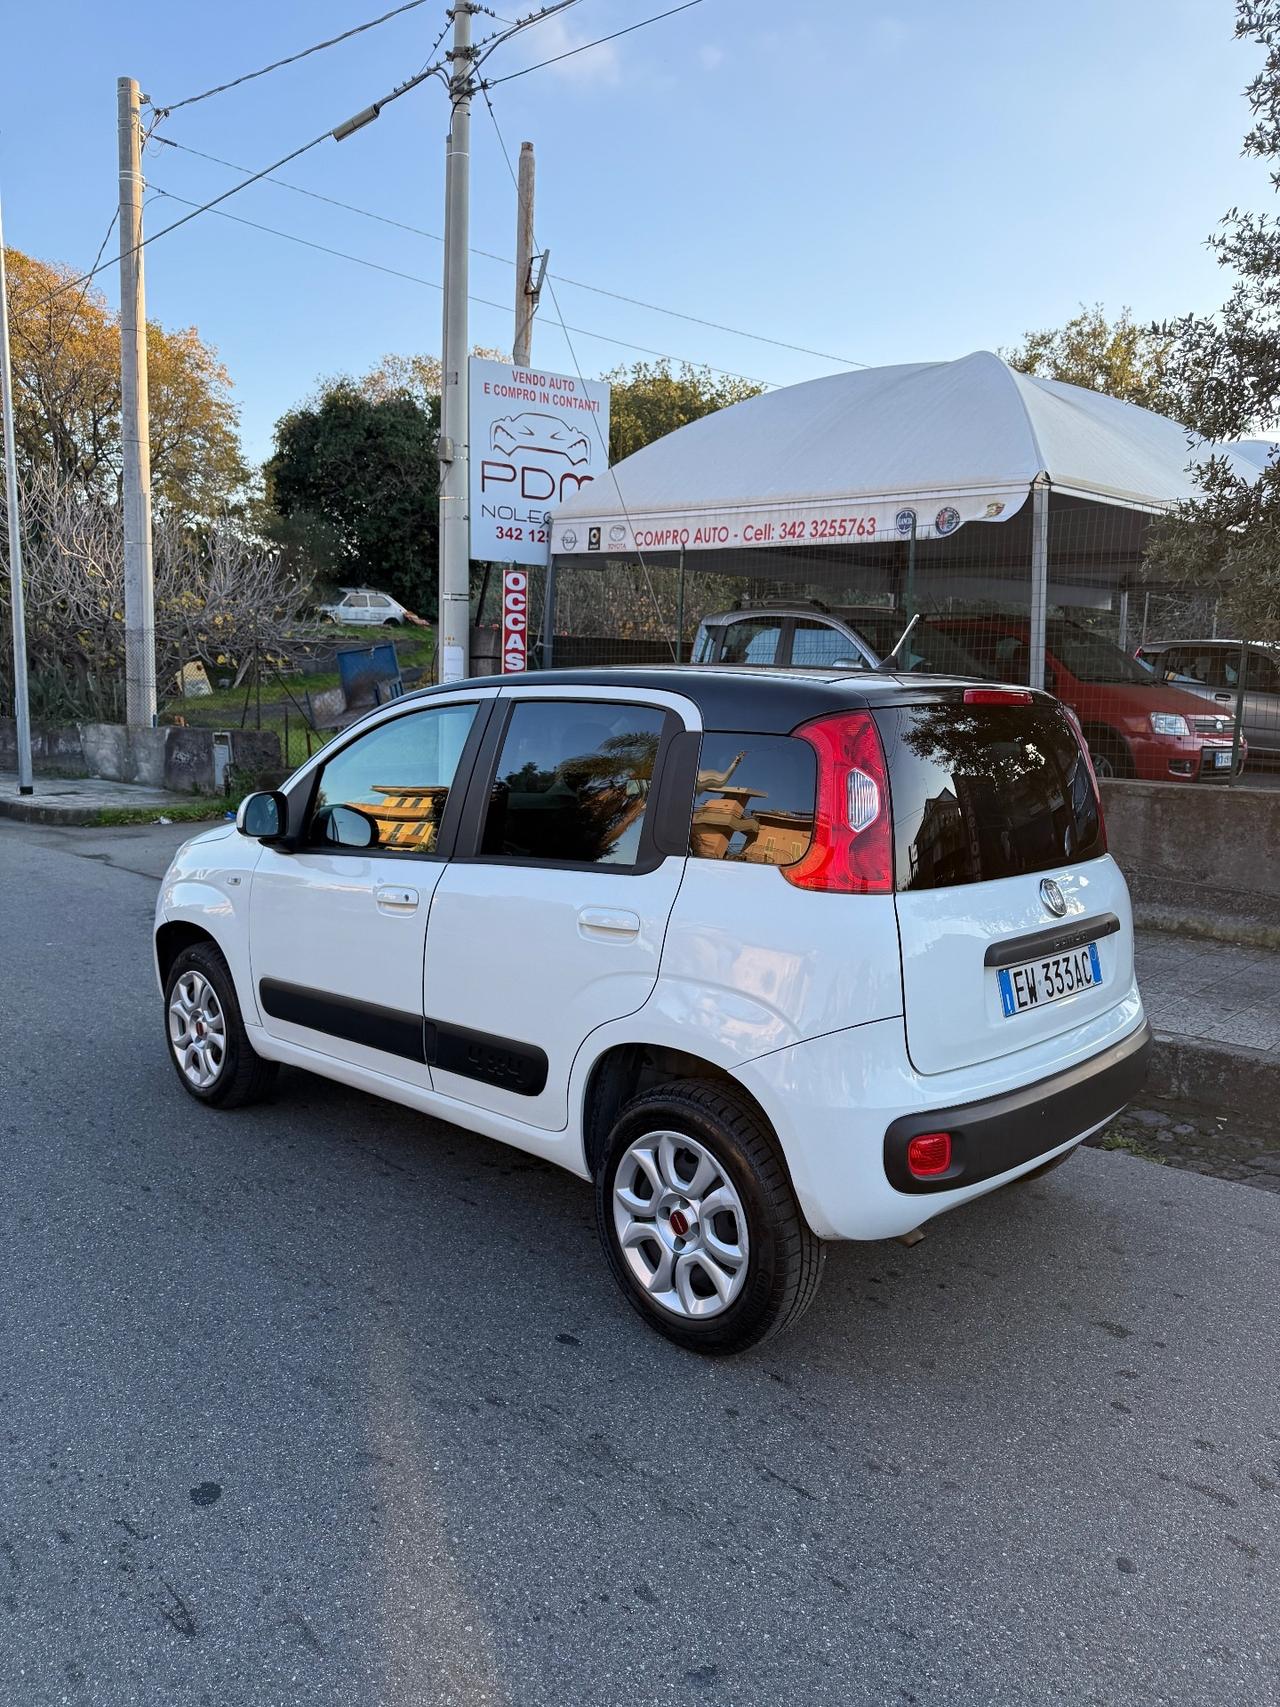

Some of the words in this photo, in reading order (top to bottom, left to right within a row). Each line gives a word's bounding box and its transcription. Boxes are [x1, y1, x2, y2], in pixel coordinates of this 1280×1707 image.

[512, 370, 546, 387] VENDO
[549, 378, 575, 392] AUTO
[483, 382, 491, 395] E
[493, 384, 536, 402] COMPRO
[539, 391, 550, 404] IN
[552, 394, 600, 413] CONTANTI
[495, 526, 523, 541] 342
[634, 528, 690, 547] COMPRO
[694, 526, 729, 544] AUTO
[743, 524, 775, 541] Cell:
[779, 521, 806, 539] 342
[809, 517, 876, 537] 3255763
[1013, 967, 1038, 1008] EW
[1041, 951, 1092, 998] 333AC
